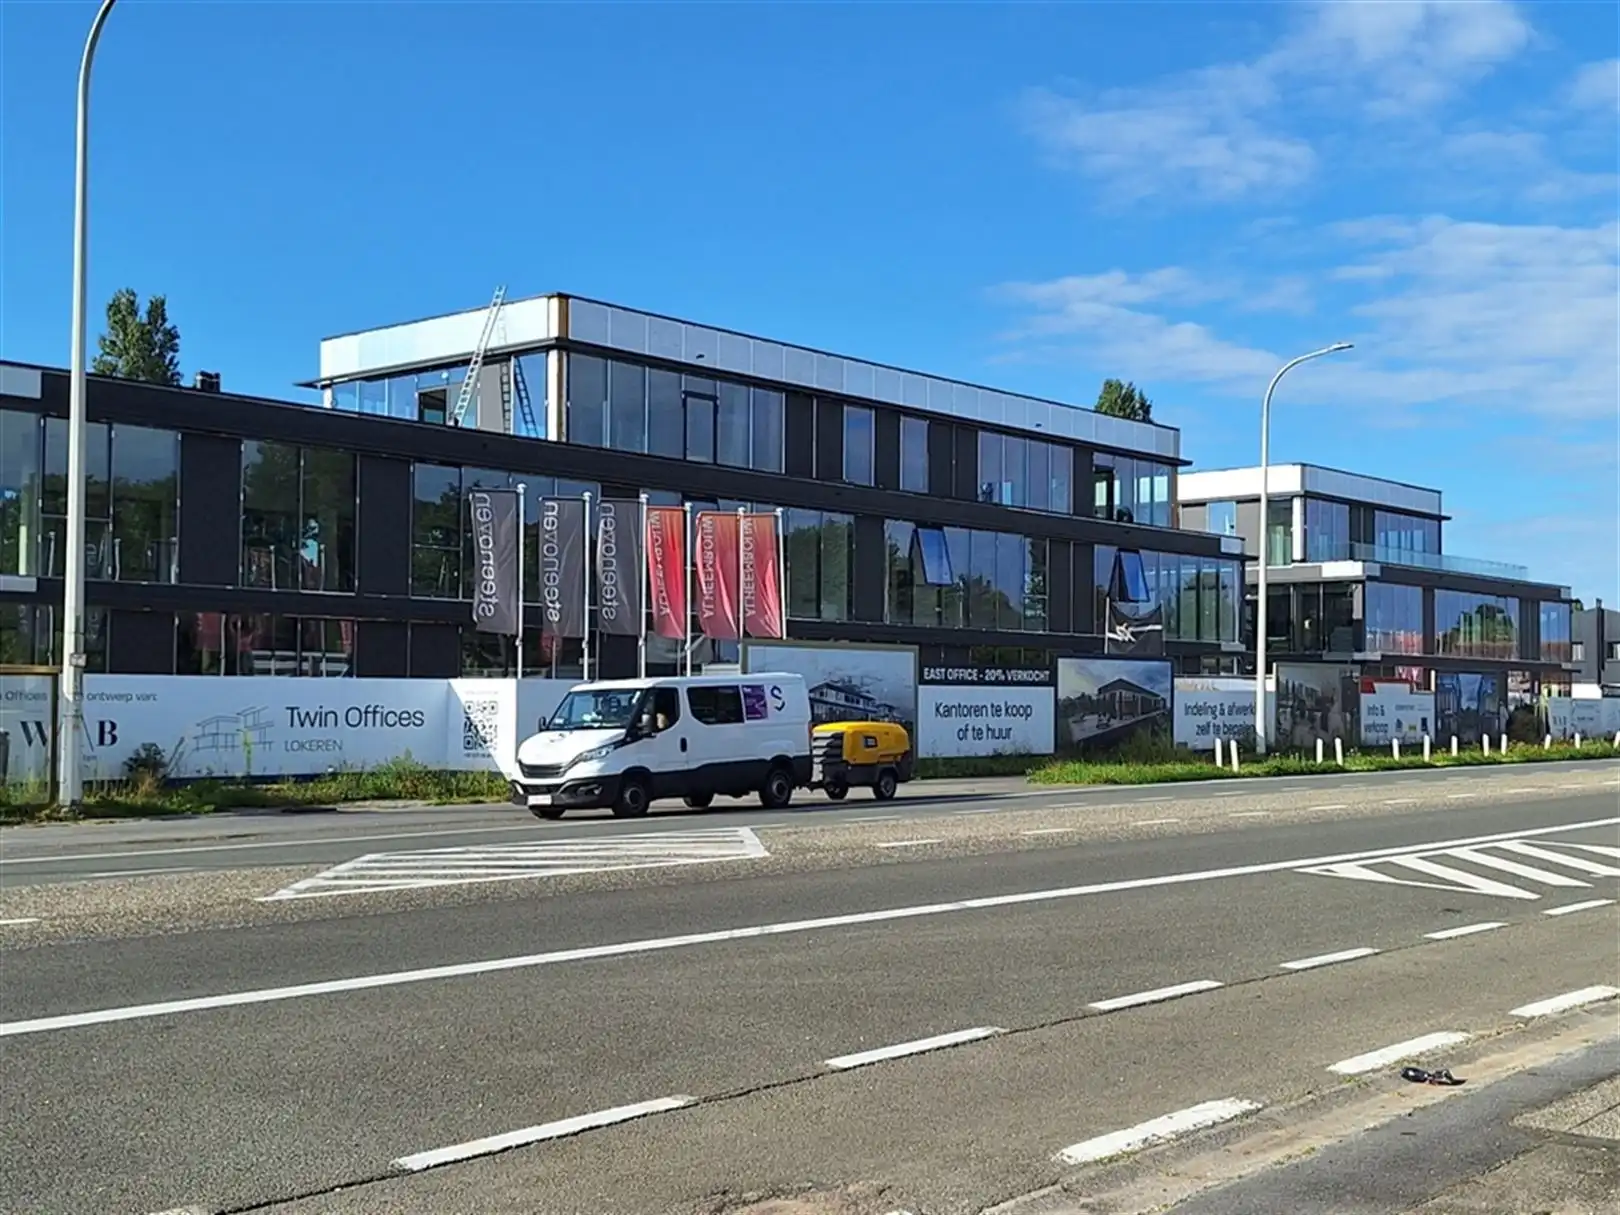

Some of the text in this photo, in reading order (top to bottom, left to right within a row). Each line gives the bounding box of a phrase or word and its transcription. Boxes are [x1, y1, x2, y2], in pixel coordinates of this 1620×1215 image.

[923, 667, 945, 680] EAST
[947, 668, 978, 680] OFFICE
[985, 669, 1005, 681] 20%
[1006, 669, 1050, 681] VERKOCHT
[87, 691, 133, 703] ontwerp
[285, 704, 425, 728] Twin Offices
[935, 701, 1033, 720] Kantoren te koop
[1185, 702, 1218, 720] Indeling
[957, 723, 1012, 741] of te huur
[284, 739, 344, 752] LOKEREN
